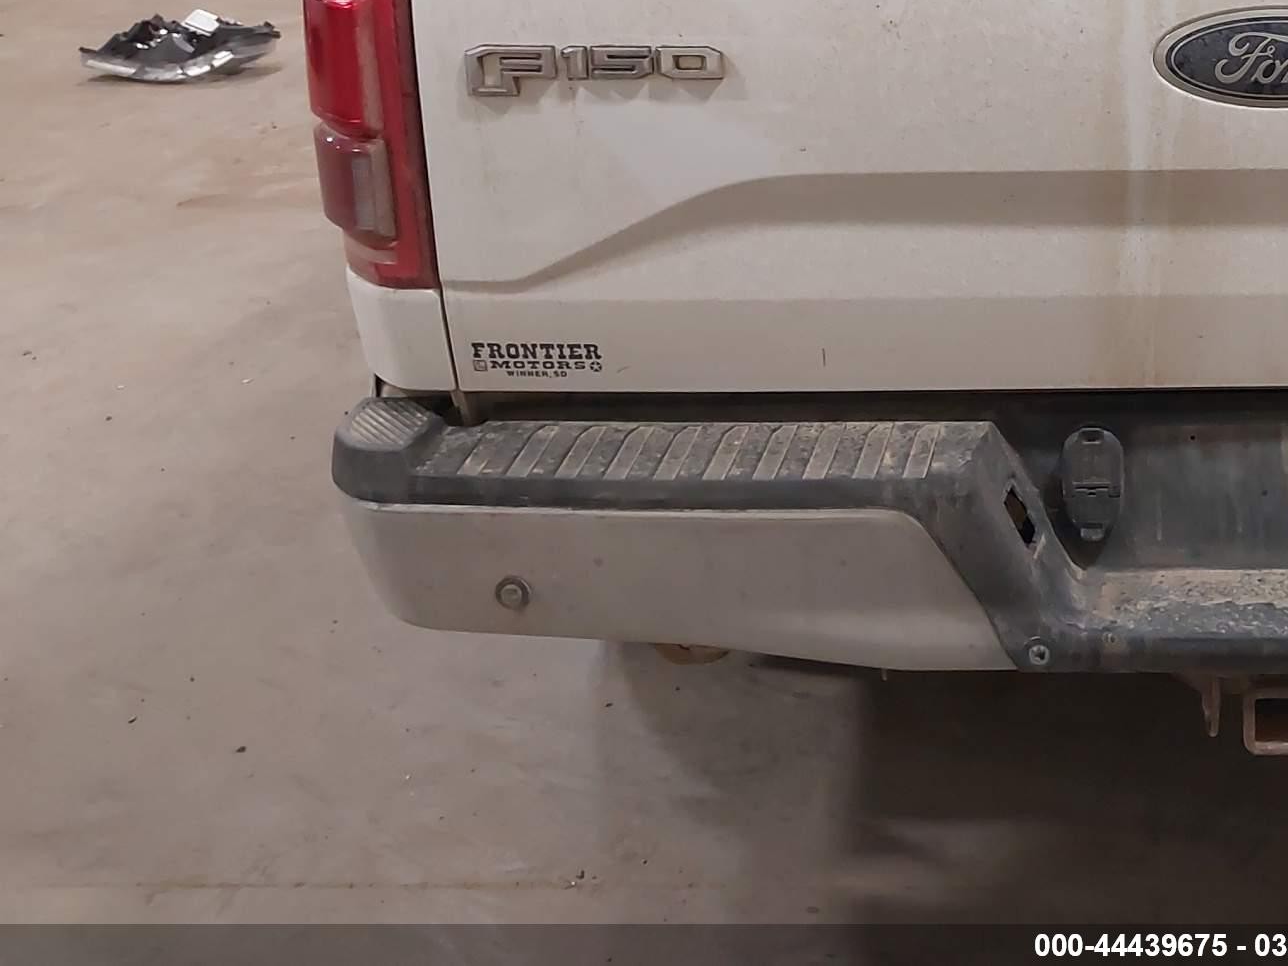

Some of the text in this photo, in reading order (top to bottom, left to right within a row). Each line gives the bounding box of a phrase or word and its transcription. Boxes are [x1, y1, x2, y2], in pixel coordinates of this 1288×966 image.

[464, 43, 725, 97] F150
[471, 342, 602, 360] FRONTIER
[490, 361, 586, 370] MOTORS
[506, 370, 568, 379] WINNER, SD
